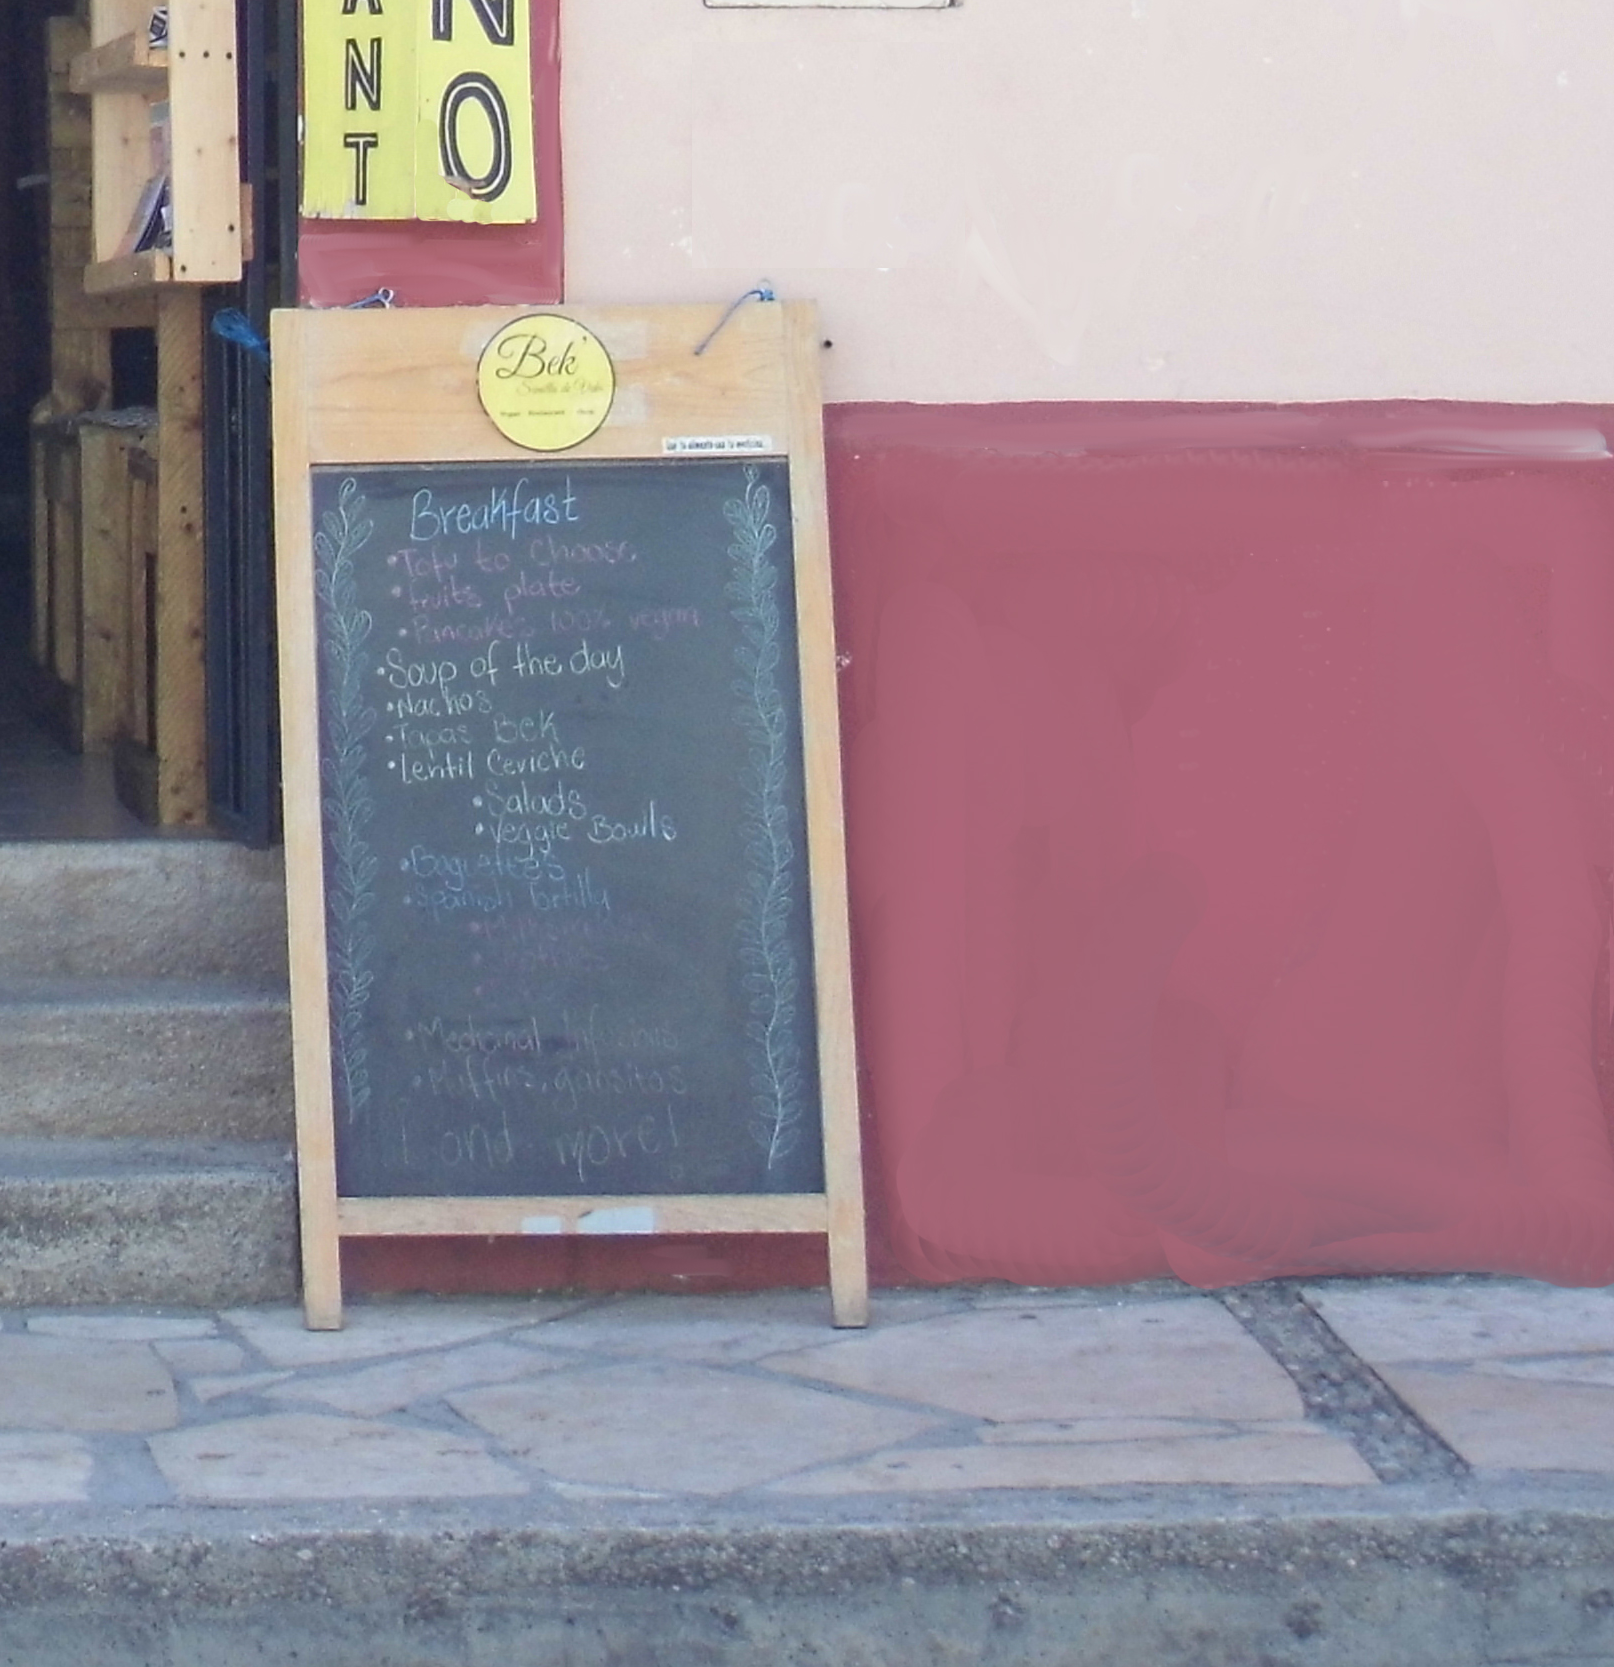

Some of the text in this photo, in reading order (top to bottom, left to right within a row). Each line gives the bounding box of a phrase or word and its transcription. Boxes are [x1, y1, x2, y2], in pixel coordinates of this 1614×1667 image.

[410, 477, 579, 540] Breakfast
[398, 548, 458, 582] Tofu
[473, 541, 511, 573] to
[503, 570, 581, 615] plate
[386, 640, 626, 692] Soup of the day
[396, 688, 493, 719] Nachos
[484, 780, 588, 820] Salads
